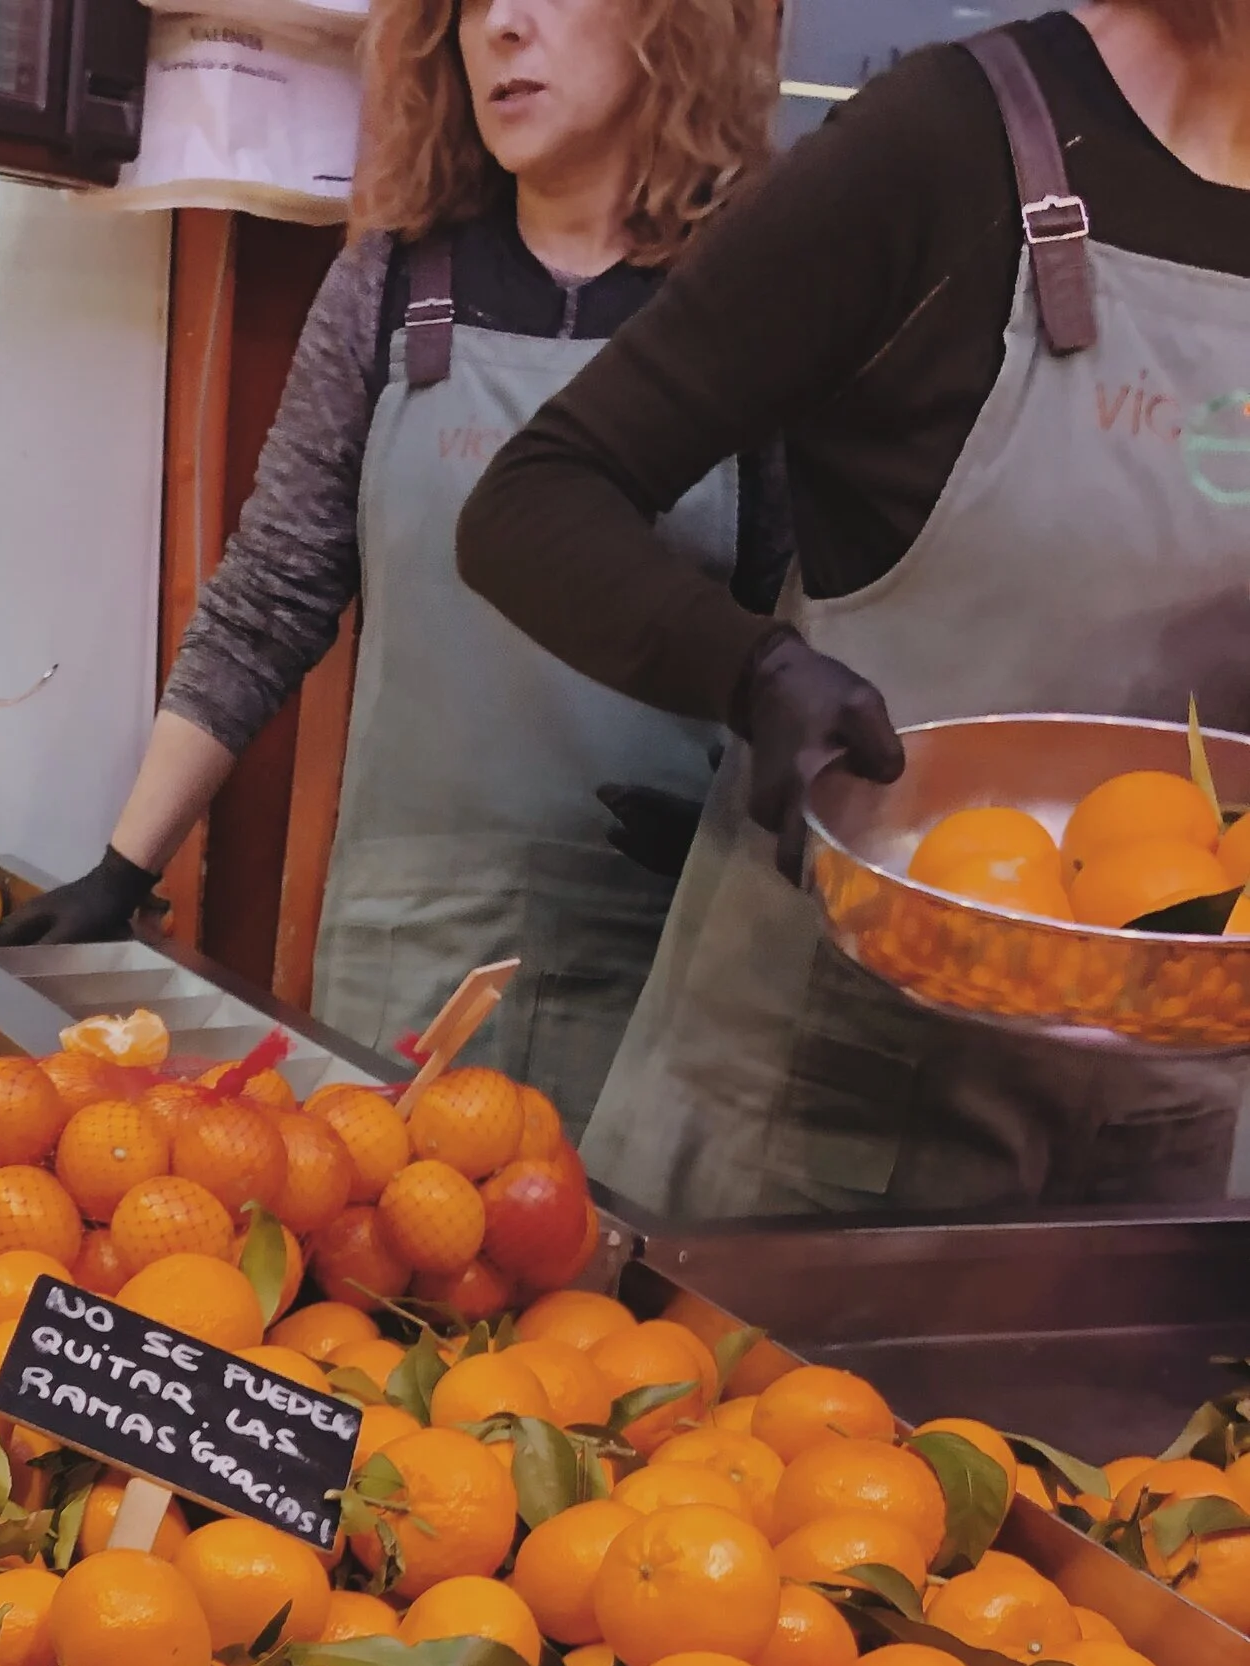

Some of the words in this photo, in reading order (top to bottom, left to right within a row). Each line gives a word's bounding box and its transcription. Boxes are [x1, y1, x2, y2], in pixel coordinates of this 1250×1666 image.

[45, 1286, 115, 1333] NO
[141, 1331, 204, 1372] SE
[223, 1362, 359, 1441] PUEDEN
[18, 1366, 178, 1455] RAMAS
[225, 1408, 301, 1460] LAS
